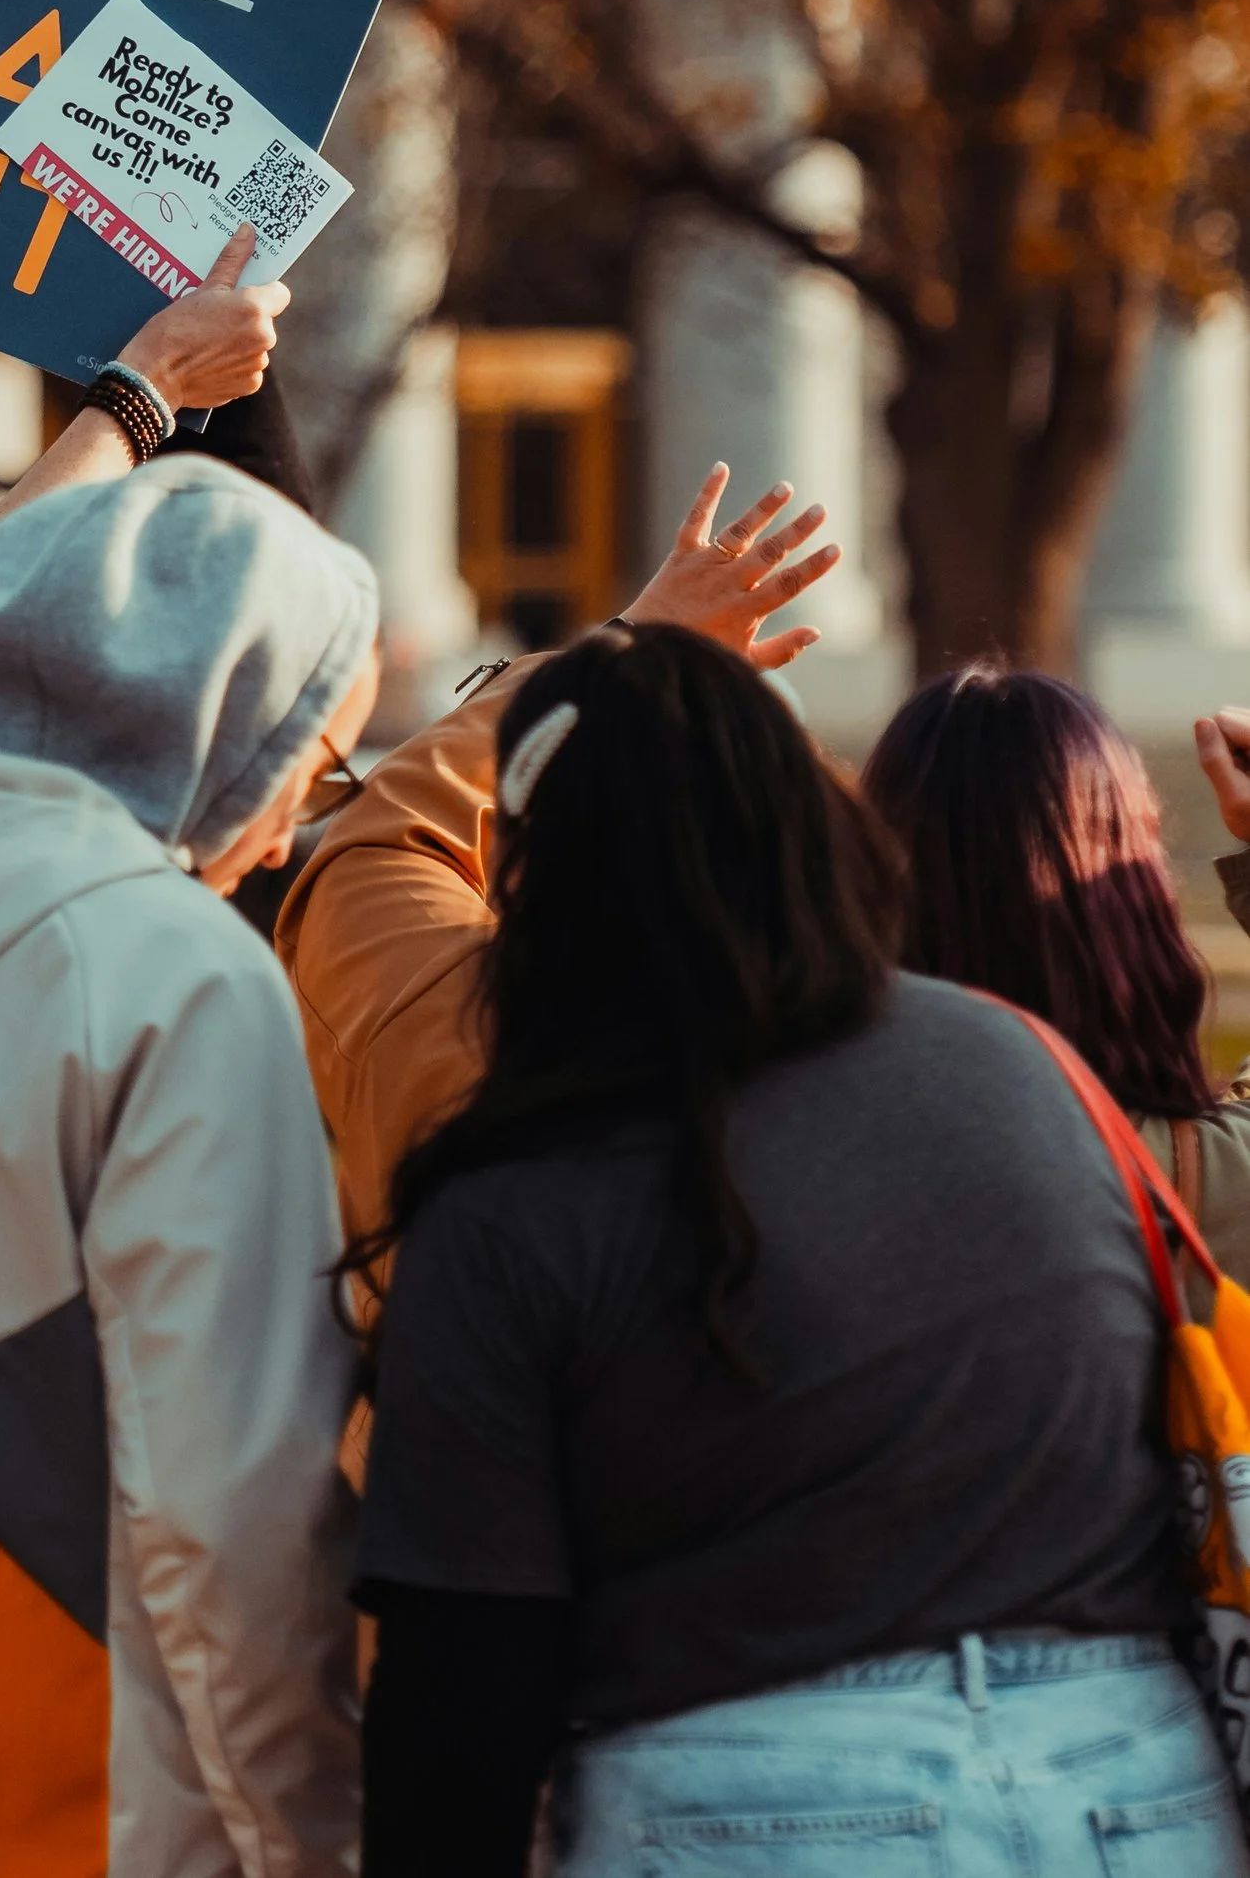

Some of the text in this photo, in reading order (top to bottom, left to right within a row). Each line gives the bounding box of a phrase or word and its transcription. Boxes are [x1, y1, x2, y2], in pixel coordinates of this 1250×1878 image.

[97, 57, 231, 135] Mobilize?
[114, 36, 234, 112] Ready to
[61, 101, 221, 189] canvas with
[91, 142, 124, 168] us
[114, 93, 191, 146] Come
[31, 153, 116, 236] WE'RE
[208, 193, 237, 220] Pledge
[268, 244, 279, 257] for
